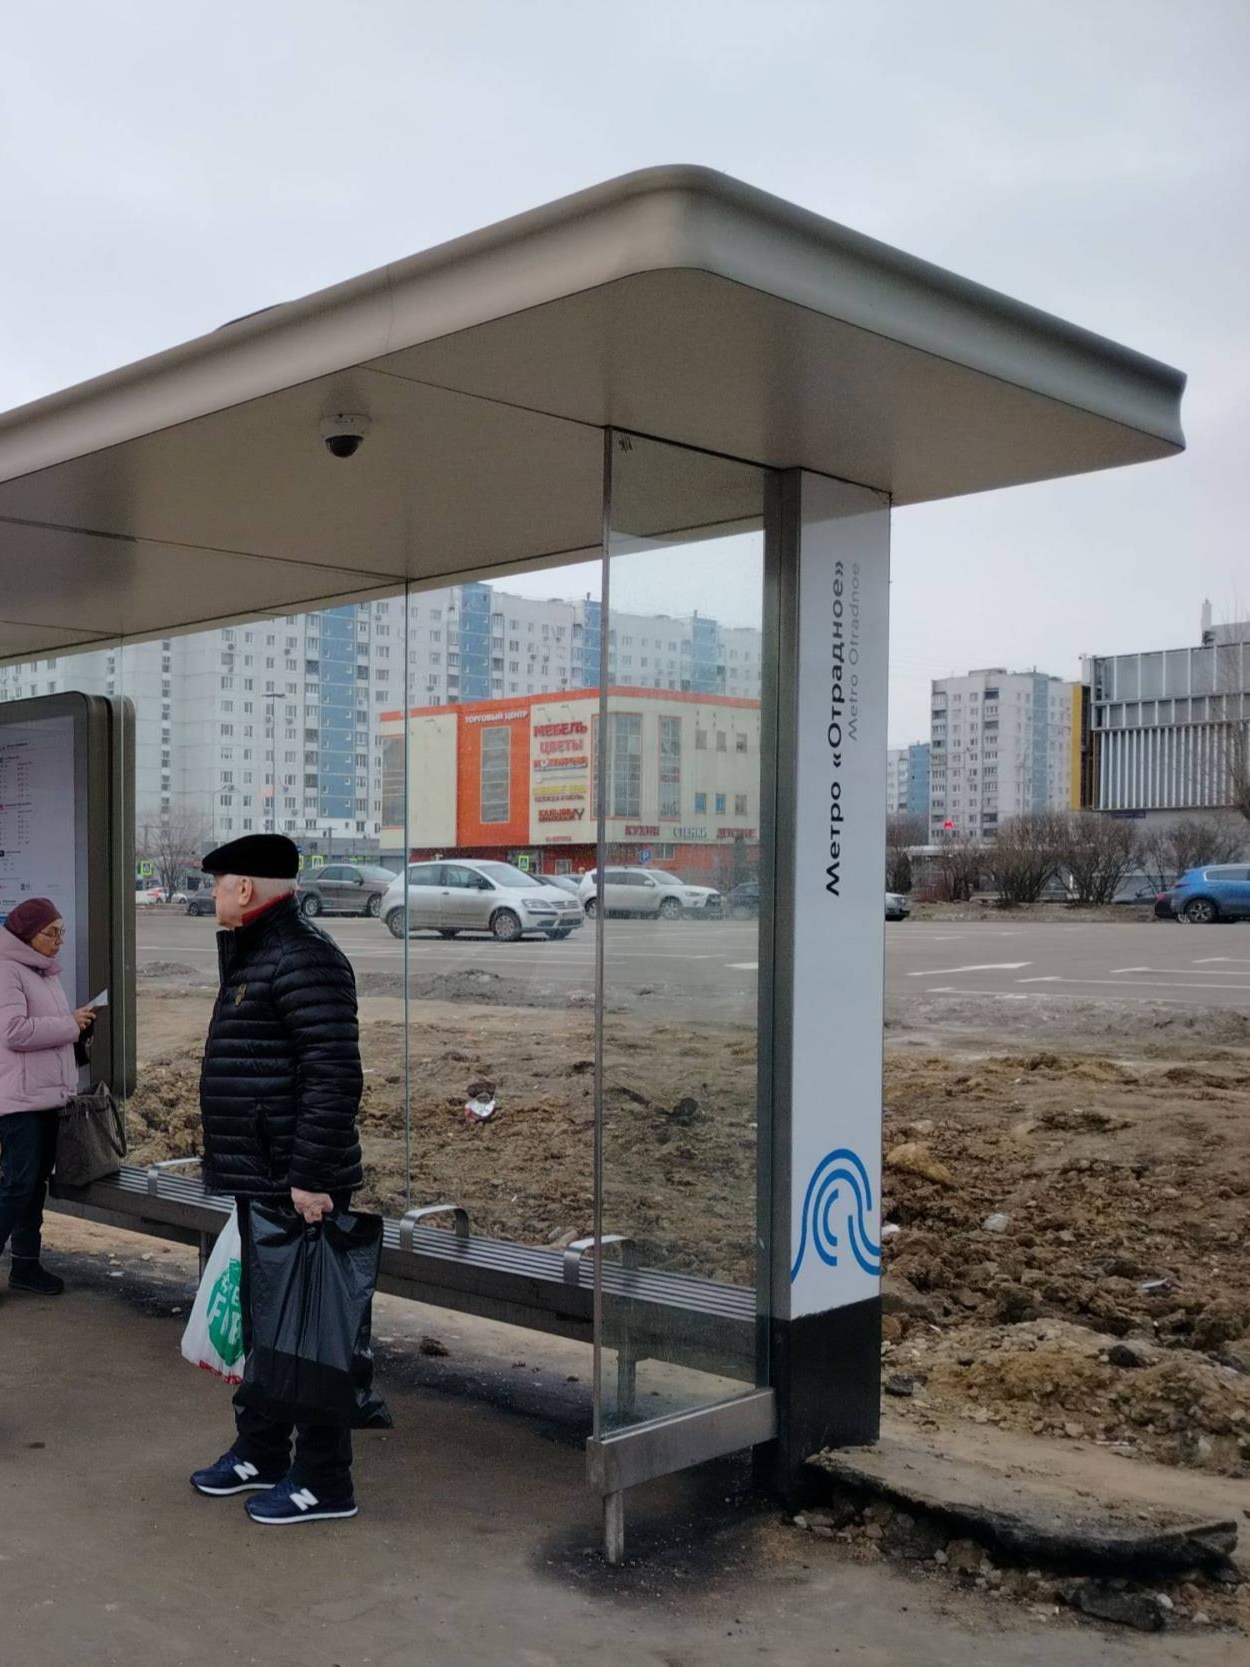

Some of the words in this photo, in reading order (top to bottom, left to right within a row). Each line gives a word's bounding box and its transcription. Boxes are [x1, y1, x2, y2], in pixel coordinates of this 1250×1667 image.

[828, 560, 845, 768] «Отрадное»
[533, 721, 588, 738] МЕБЕЛЬ
[848, 675, 860, 741] Metro
[826, 781, 844, 896] Метро
[233, 1461, 259, 1481] N
[289, 1487, 319, 1511] N
